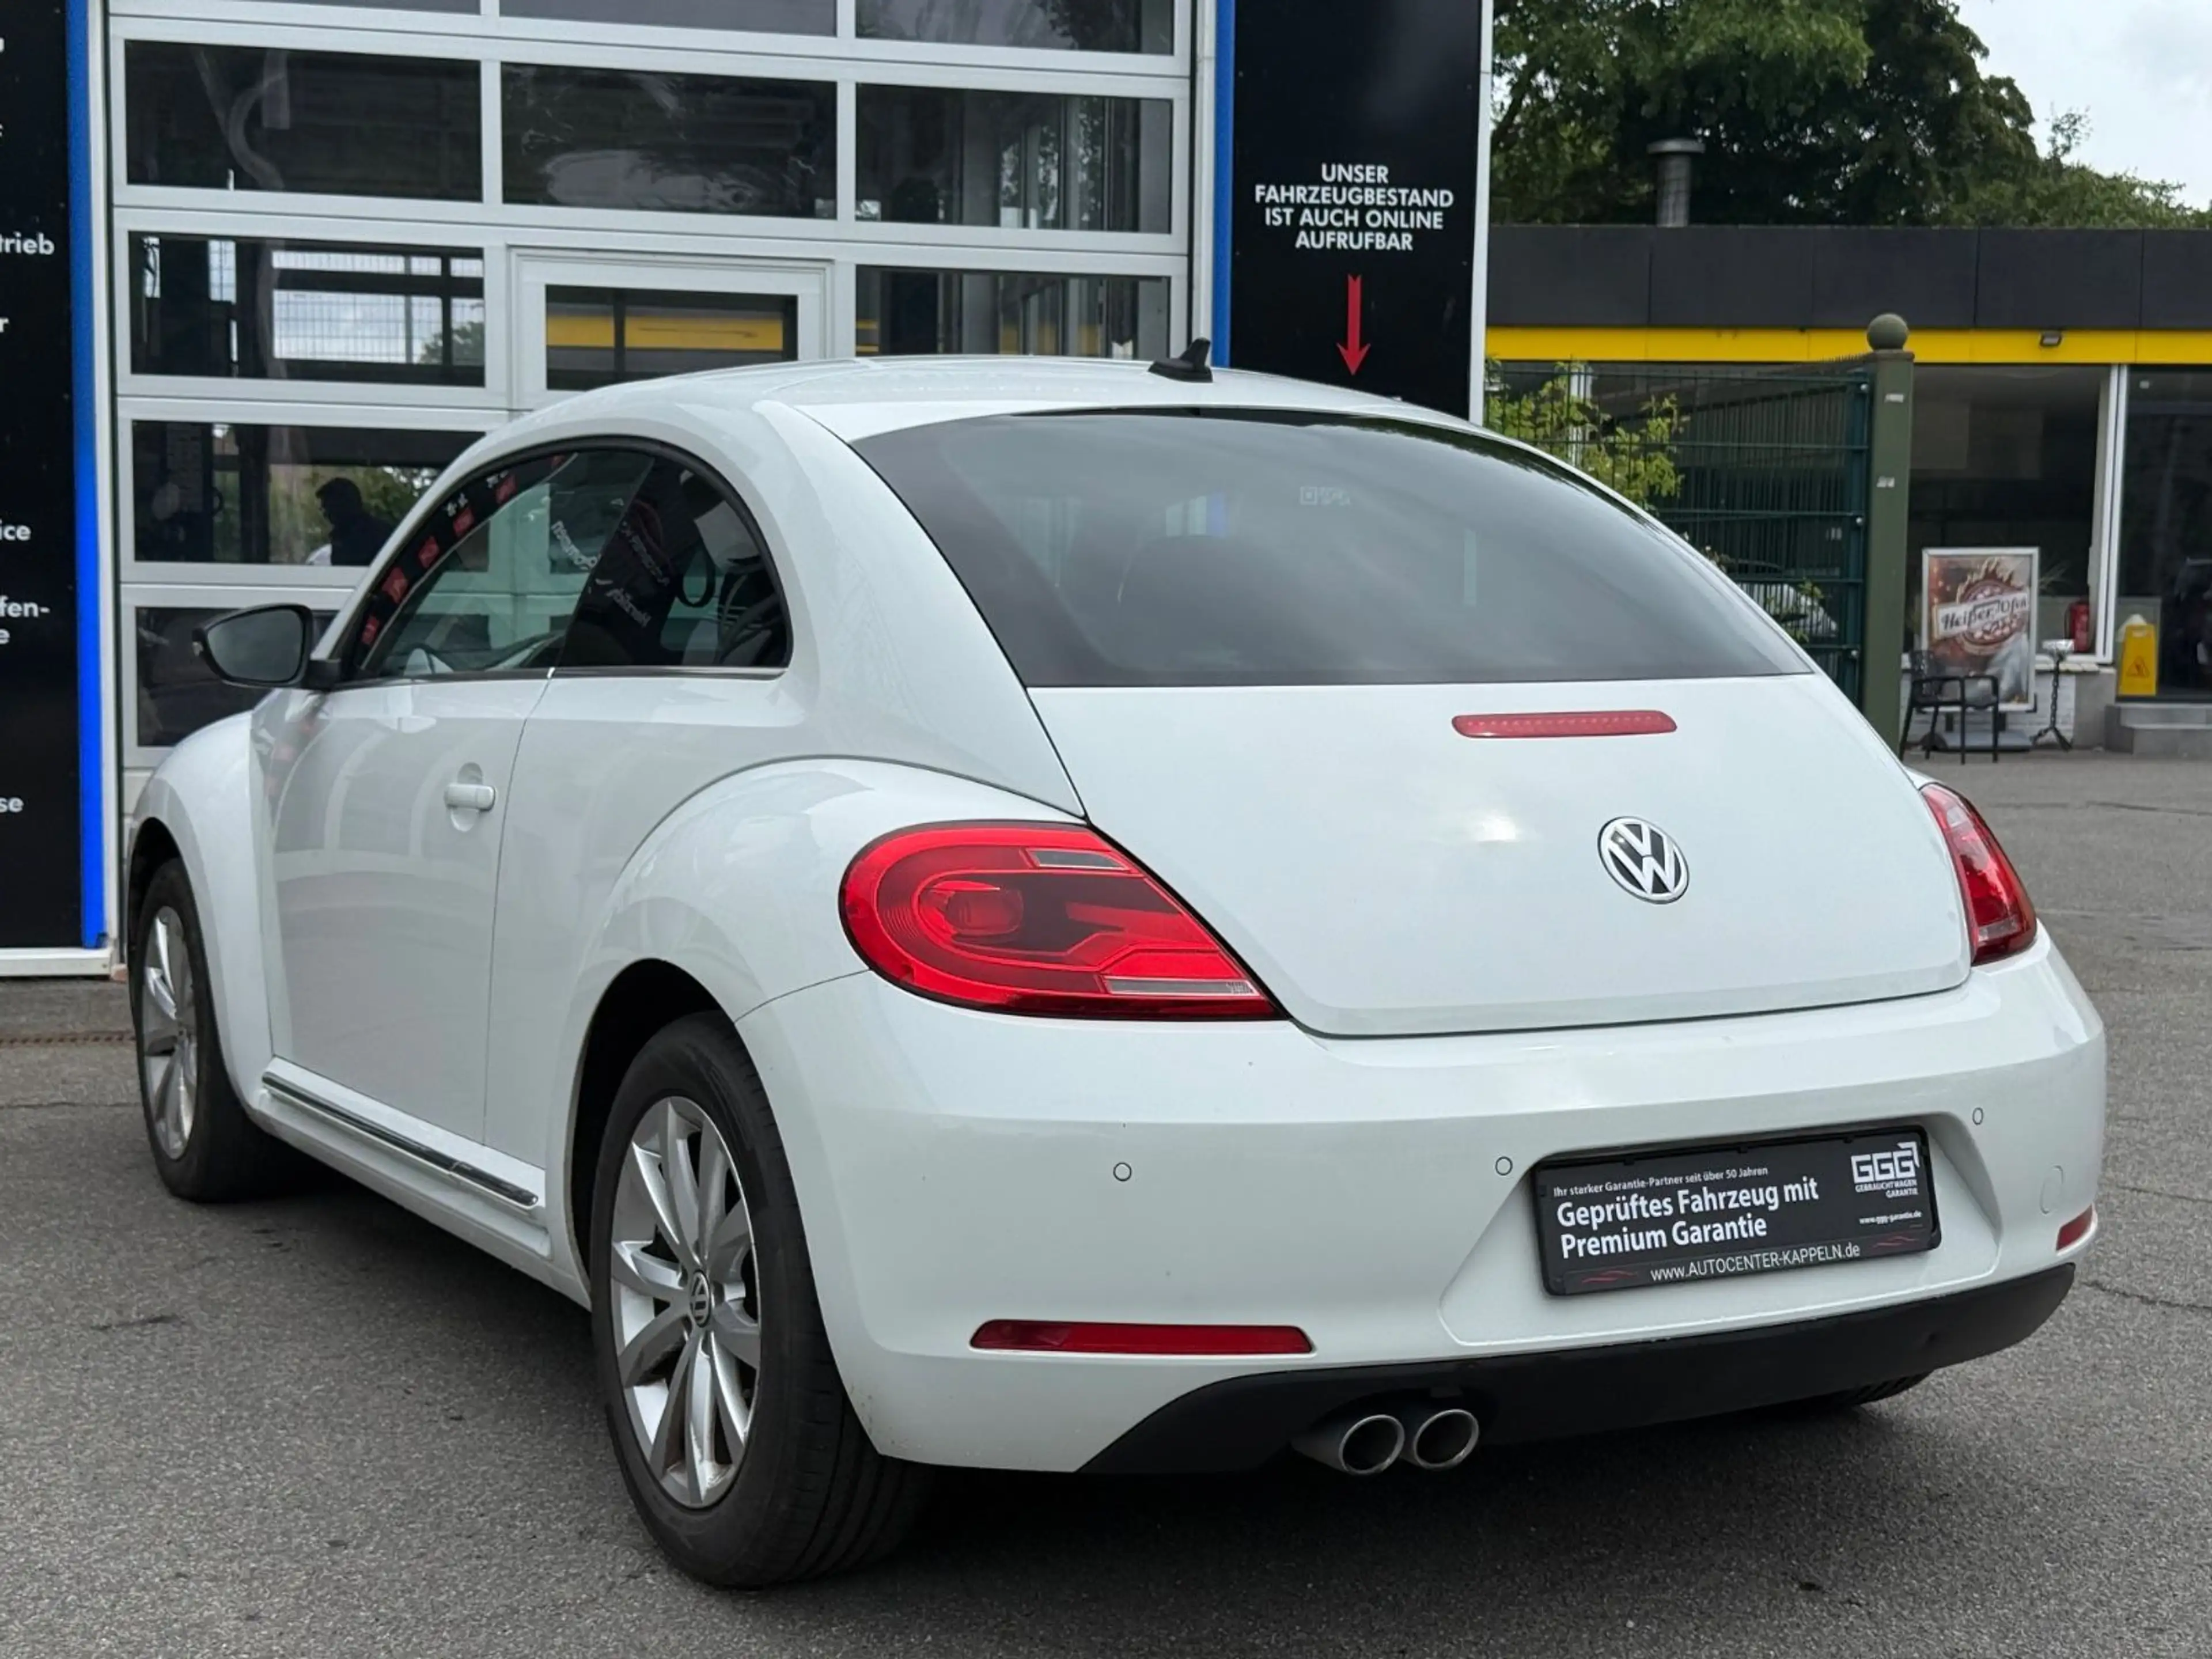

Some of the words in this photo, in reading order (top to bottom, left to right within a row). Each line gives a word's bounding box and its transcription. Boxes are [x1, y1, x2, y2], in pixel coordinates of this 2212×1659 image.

[1321, 163, 1389, 184] UNSER
[1255, 185, 1454, 207] FAHRZEUGBESTAND
[1264, 207, 1294, 226] IST
[1299, 209, 1359, 227] AUCH
[1365, 210, 1444, 230] ONLINE
[1295, 230, 1413, 251] AUFRUFBAR
[1601, 819, 1686, 901] VW
[1553, 1186, 1567, 1198] Ihr
[1570, 1183, 1603, 1196] starker
[1605, 1175, 1683, 1192] Garantie-Partner
[1685, 1172, 1702, 1183] seit
[1703, 1169, 1724, 1181] über
[1725, 1168, 1737, 1179] 50
[1738, 1166, 1768, 1177] Jahren
[1851, 1149, 1916, 1184] GGG
[1556, 1193, 1673, 1230] Geprüftes
[1677, 1185, 1780, 1214] Fahrzeug
[1783, 1176, 1819, 1203] mit
[1885, 1187, 1919, 1199] GARANTIE
[1560, 1226, 1668, 1259] Premium
[1672, 1212, 1768, 1247] Garantie
[1650, 1241, 1861, 1282] www.AUTOCENTER-KAPPELN.de
